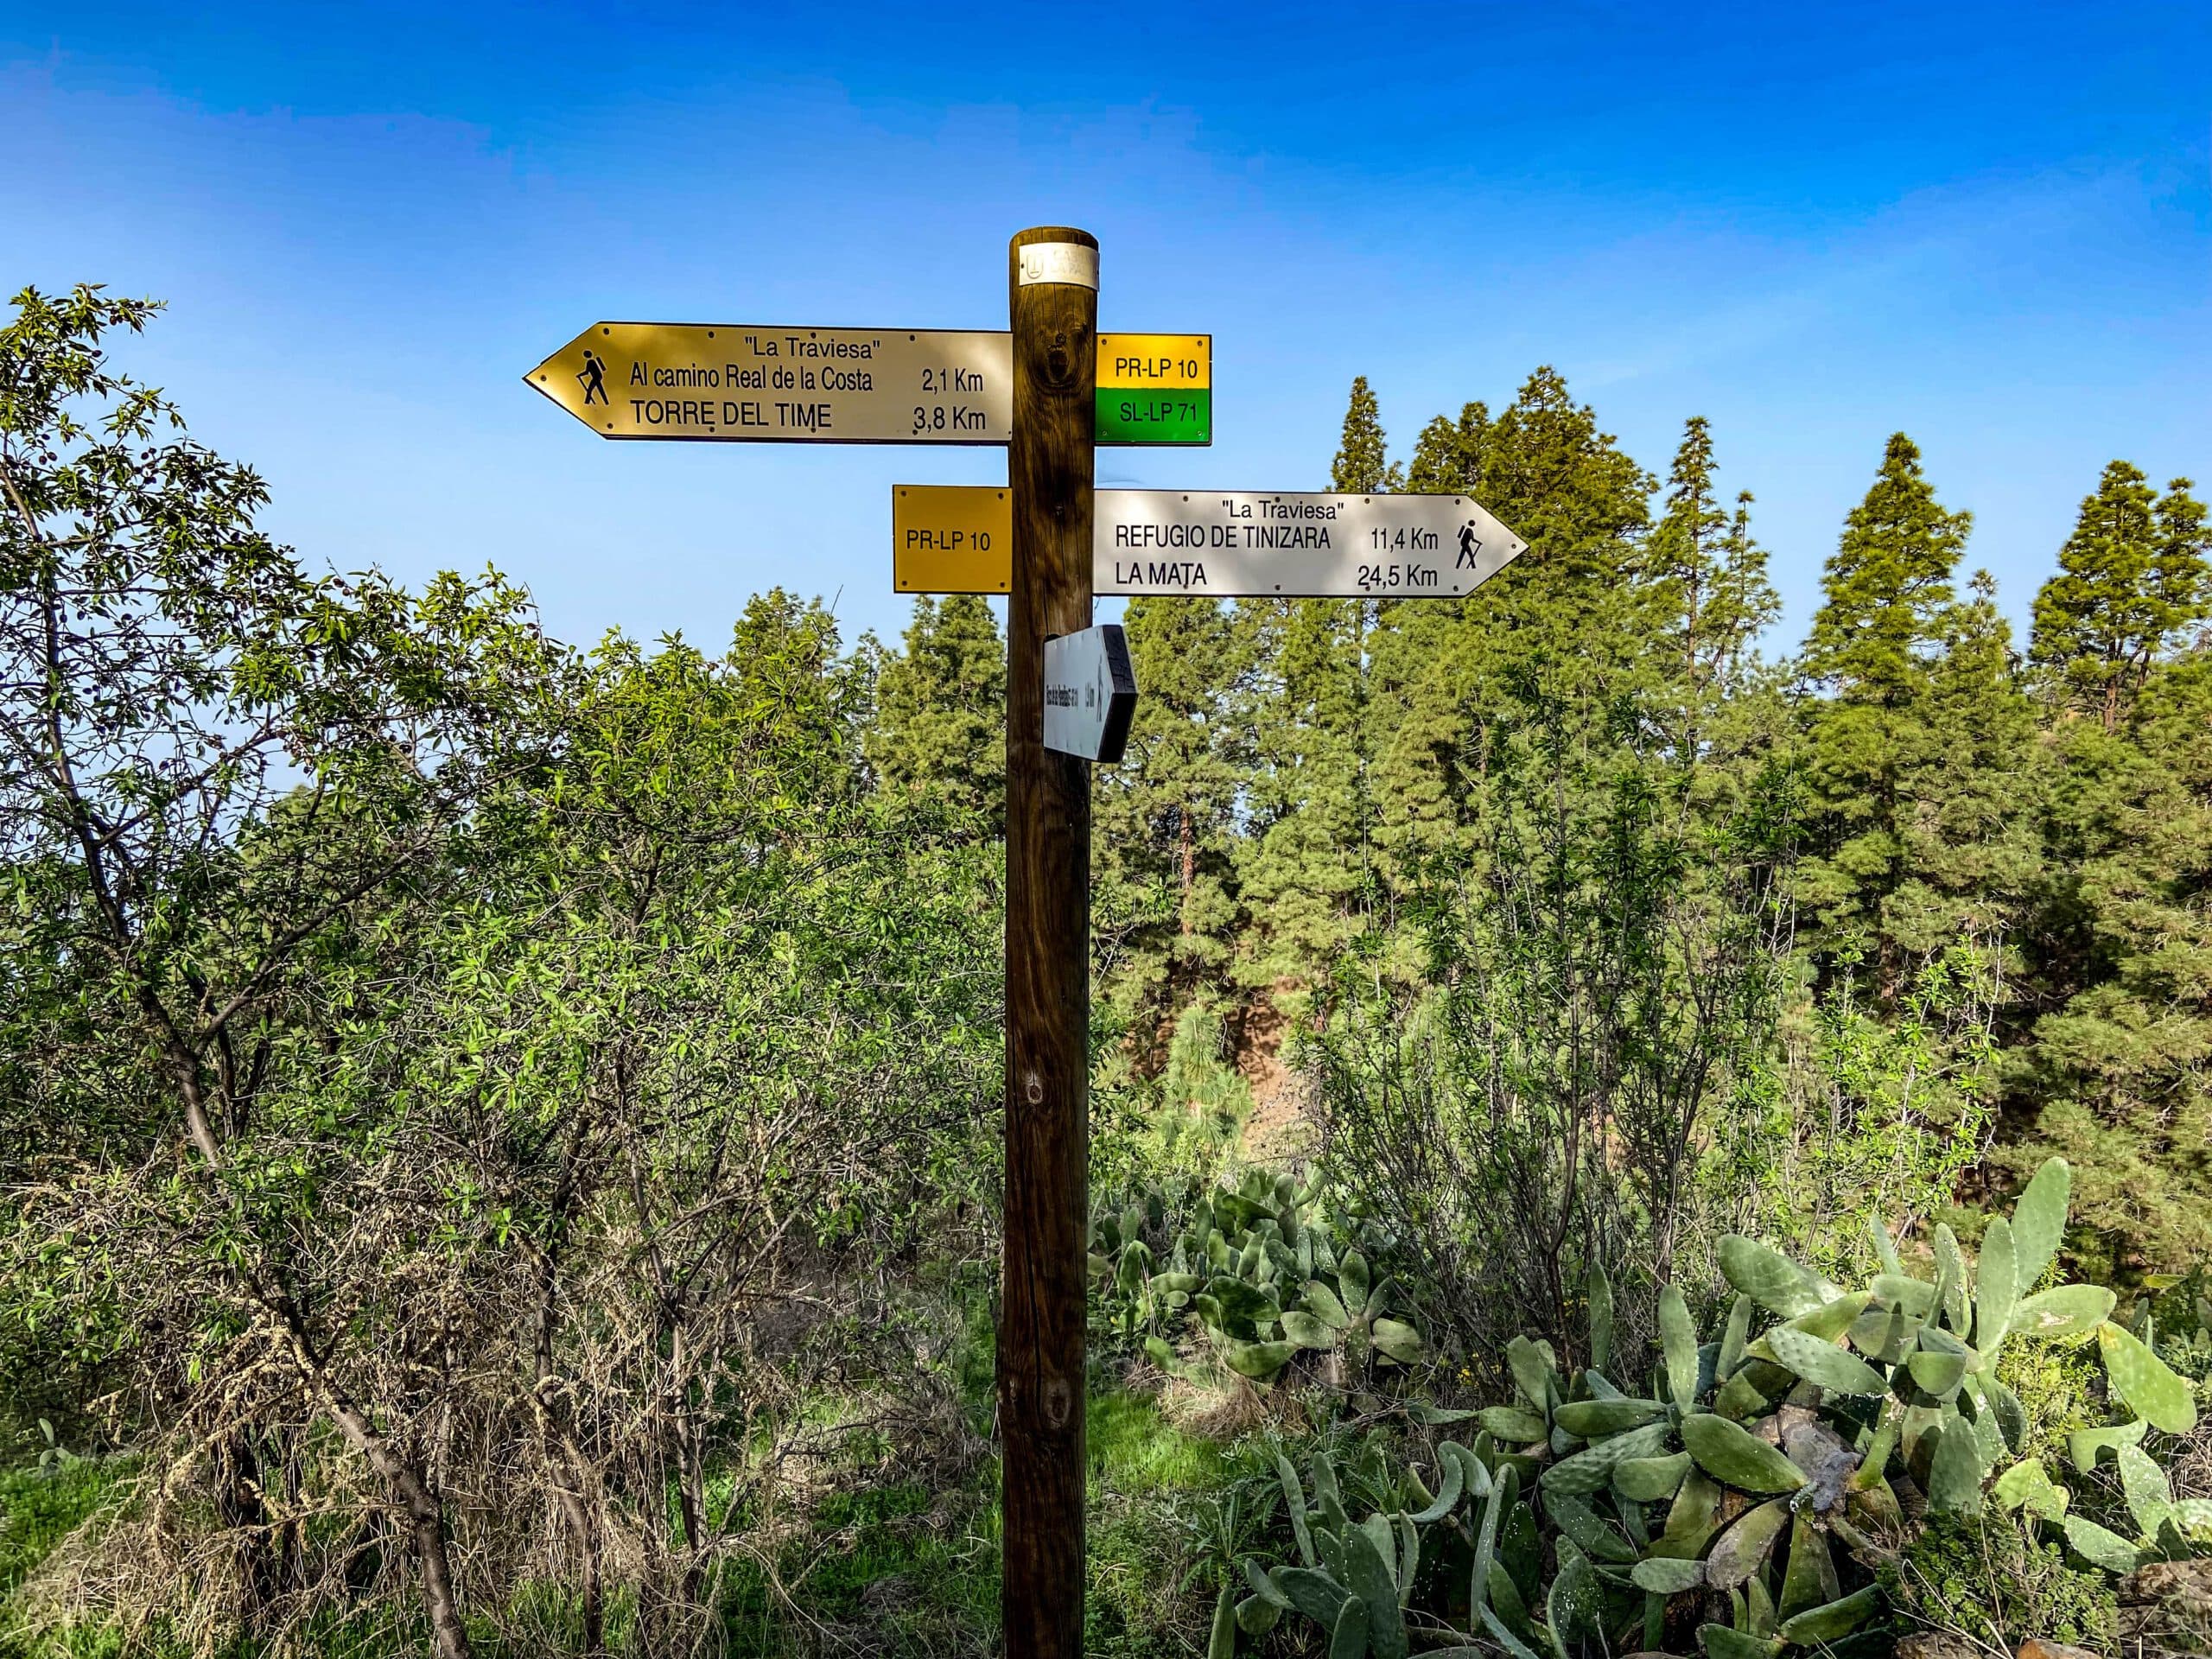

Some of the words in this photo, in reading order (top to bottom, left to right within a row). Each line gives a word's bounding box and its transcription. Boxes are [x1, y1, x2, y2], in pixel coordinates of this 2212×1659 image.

[745, 336, 779, 357] "La
[785, 337, 880, 359] Traviesa"
[630, 361, 648, 386] Al
[654, 363, 719, 388] camino
[726, 364, 766, 389] Real
[772, 365, 794, 389] de
[800, 365, 816, 390] la
[822, 365, 873, 391] Costa
[1116, 358, 1172, 378] PR-LP
[1178, 359, 1198, 378] 10
[922, 368, 946, 395] 2,1
[955, 368, 983, 391] Km
[630, 399, 715, 425] TORRE
[723, 401, 769, 426] DEL
[775, 403, 832, 428] TIME
[913, 406, 945, 433] 3,8
[953, 406, 986, 429] Km
[1120, 403, 1173, 422] SL-LP
[1178, 403, 1197, 422] 71
[1223, 500, 1252, 518] "La
[1258, 500, 1344, 519] Traviesa"
[906, 530, 963, 550] PR-LP
[970, 532, 990, 551] 10
[1116, 524, 1205, 548] REFUGIO
[1211, 525, 1237, 548] DE
[1243, 525, 1332, 549] TINIZARA
[1371, 527, 1405, 553] 11,4
[1411, 527, 1438, 550] Km
[1116, 563, 1143, 585] LA
[1149, 563, 1207, 585] MATA
[1357, 564, 1400, 589] 24,5
[1407, 564, 1438, 587] Km
